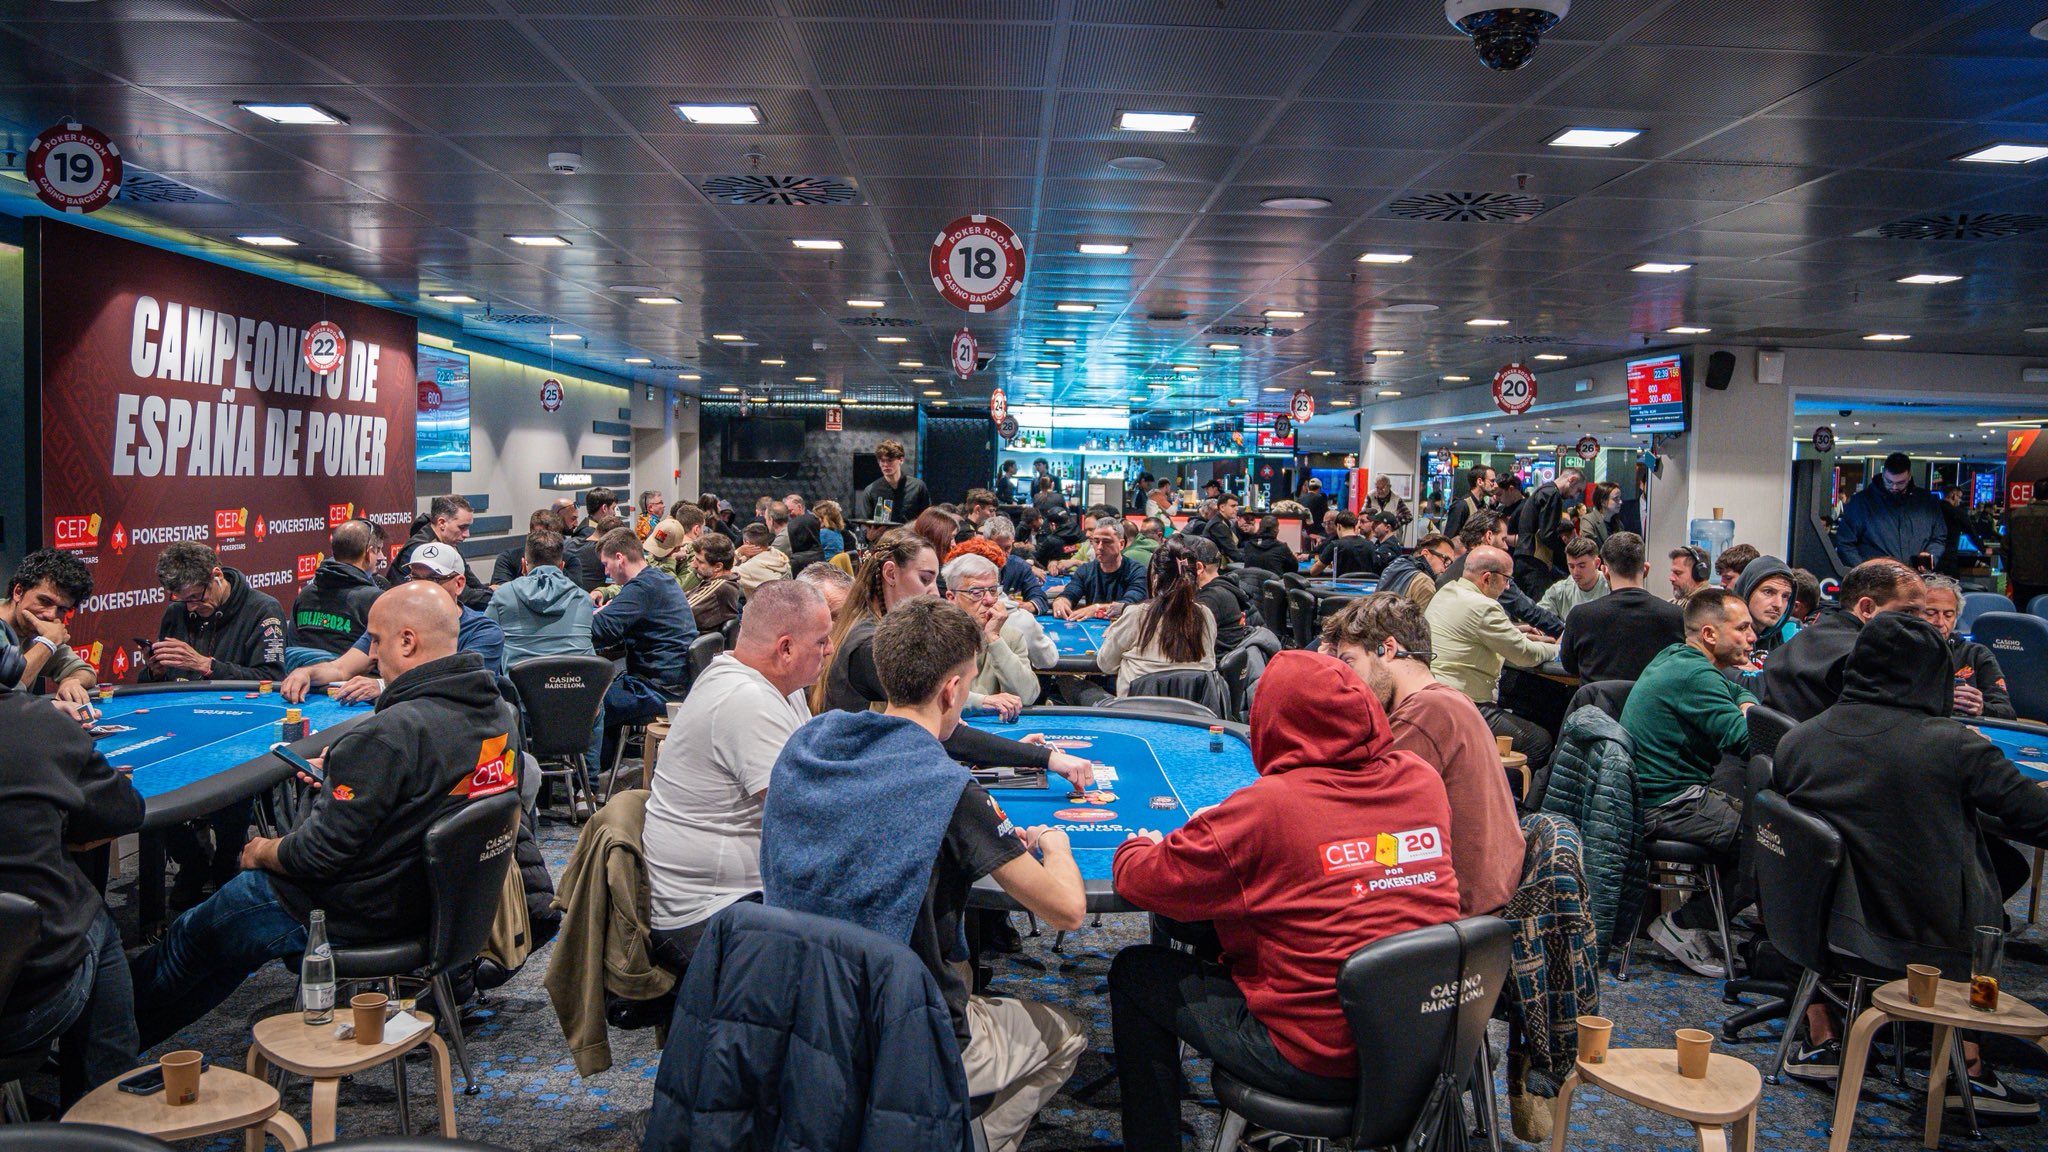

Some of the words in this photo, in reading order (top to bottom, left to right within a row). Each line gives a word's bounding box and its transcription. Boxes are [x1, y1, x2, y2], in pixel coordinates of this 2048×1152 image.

[44, 134, 77, 150] POKER
[80, 135, 108, 156] ROOM
[53, 152, 94, 184] 19
[40, 177, 66, 202] CASINO
[67, 180, 110, 204] BARCELONA
[949, 227, 981, 244] POKER
[984, 228, 1010, 250] ROOM
[958, 247, 997, 279] 18
[943, 274, 969, 300] CASINO
[970, 275, 1012, 302] BARCELONA
[313, 338, 335, 356] 22
[960, 343, 970, 362] 21
[348, 340, 380, 403] DE
[546, 389, 557, 400] 25
[1503, 380, 1527, 397] 20
[995, 400, 1002, 411] 24
[1297, 400, 1308, 411] 23
[113, 388, 256, 477] ESPAÑA
[263, 408, 302, 476] DE
[305, 411, 388, 477] POKER
[1003, 422, 1013, 431] 28
[1582, 444, 1594, 453] 26
[1817, 435, 1829, 444] 30
[2011, 485, 2034, 501] CE
[216, 512, 238, 529] CEP
[330, 506, 347, 521] CEP
[369, 511, 412, 525] POKERSTARS
[56, 519, 88, 539] CEP
[132, 524, 209, 545] POKERSTARS
[269, 517, 325, 535] POKERSTARS
[298, 557, 316, 573] CEP
[245, 569, 293, 590] KERSTARS
[80, 586, 165, 614] POKERSTARS
[1993, 643, 2024, 651] BARCELONA
[1995, 638, 2020, 646] CASINO
[473, 760, 504, 786] CEP
[1758, 824, 1781, 845] CASINO
[1326, 841, 1370, 865] CEP
[1405, 832, 1435, 853] 20
[1385, 867, 1404, 875] POR
[1369, 871, 1437, 891] POKERSTARS
[1430, 973, 1481, 999] CASINO
[1421, 985, 1484, 1014] BARCLONA
